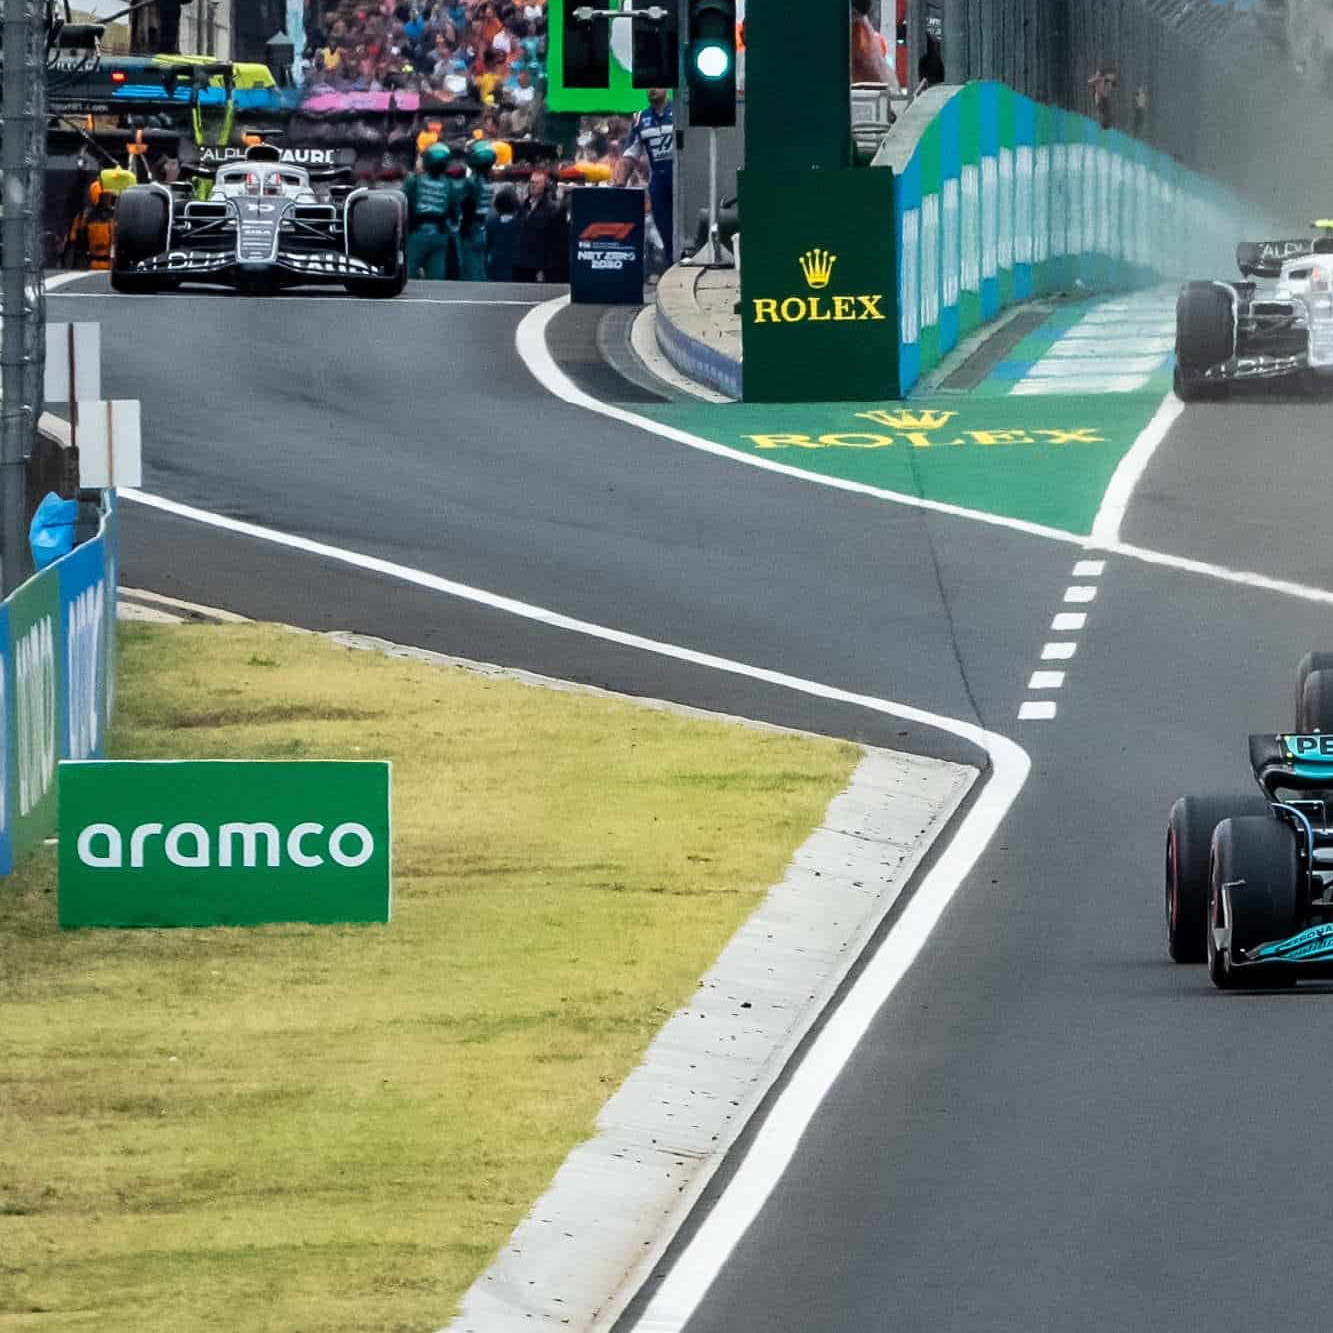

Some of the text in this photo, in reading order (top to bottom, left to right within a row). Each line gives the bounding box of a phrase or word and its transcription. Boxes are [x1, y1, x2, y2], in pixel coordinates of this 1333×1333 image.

[753, 295, 886, 323] ROLEX
[740, 428, 1107, 450] ROLEX
[77, 822, 374, 868] aramco
